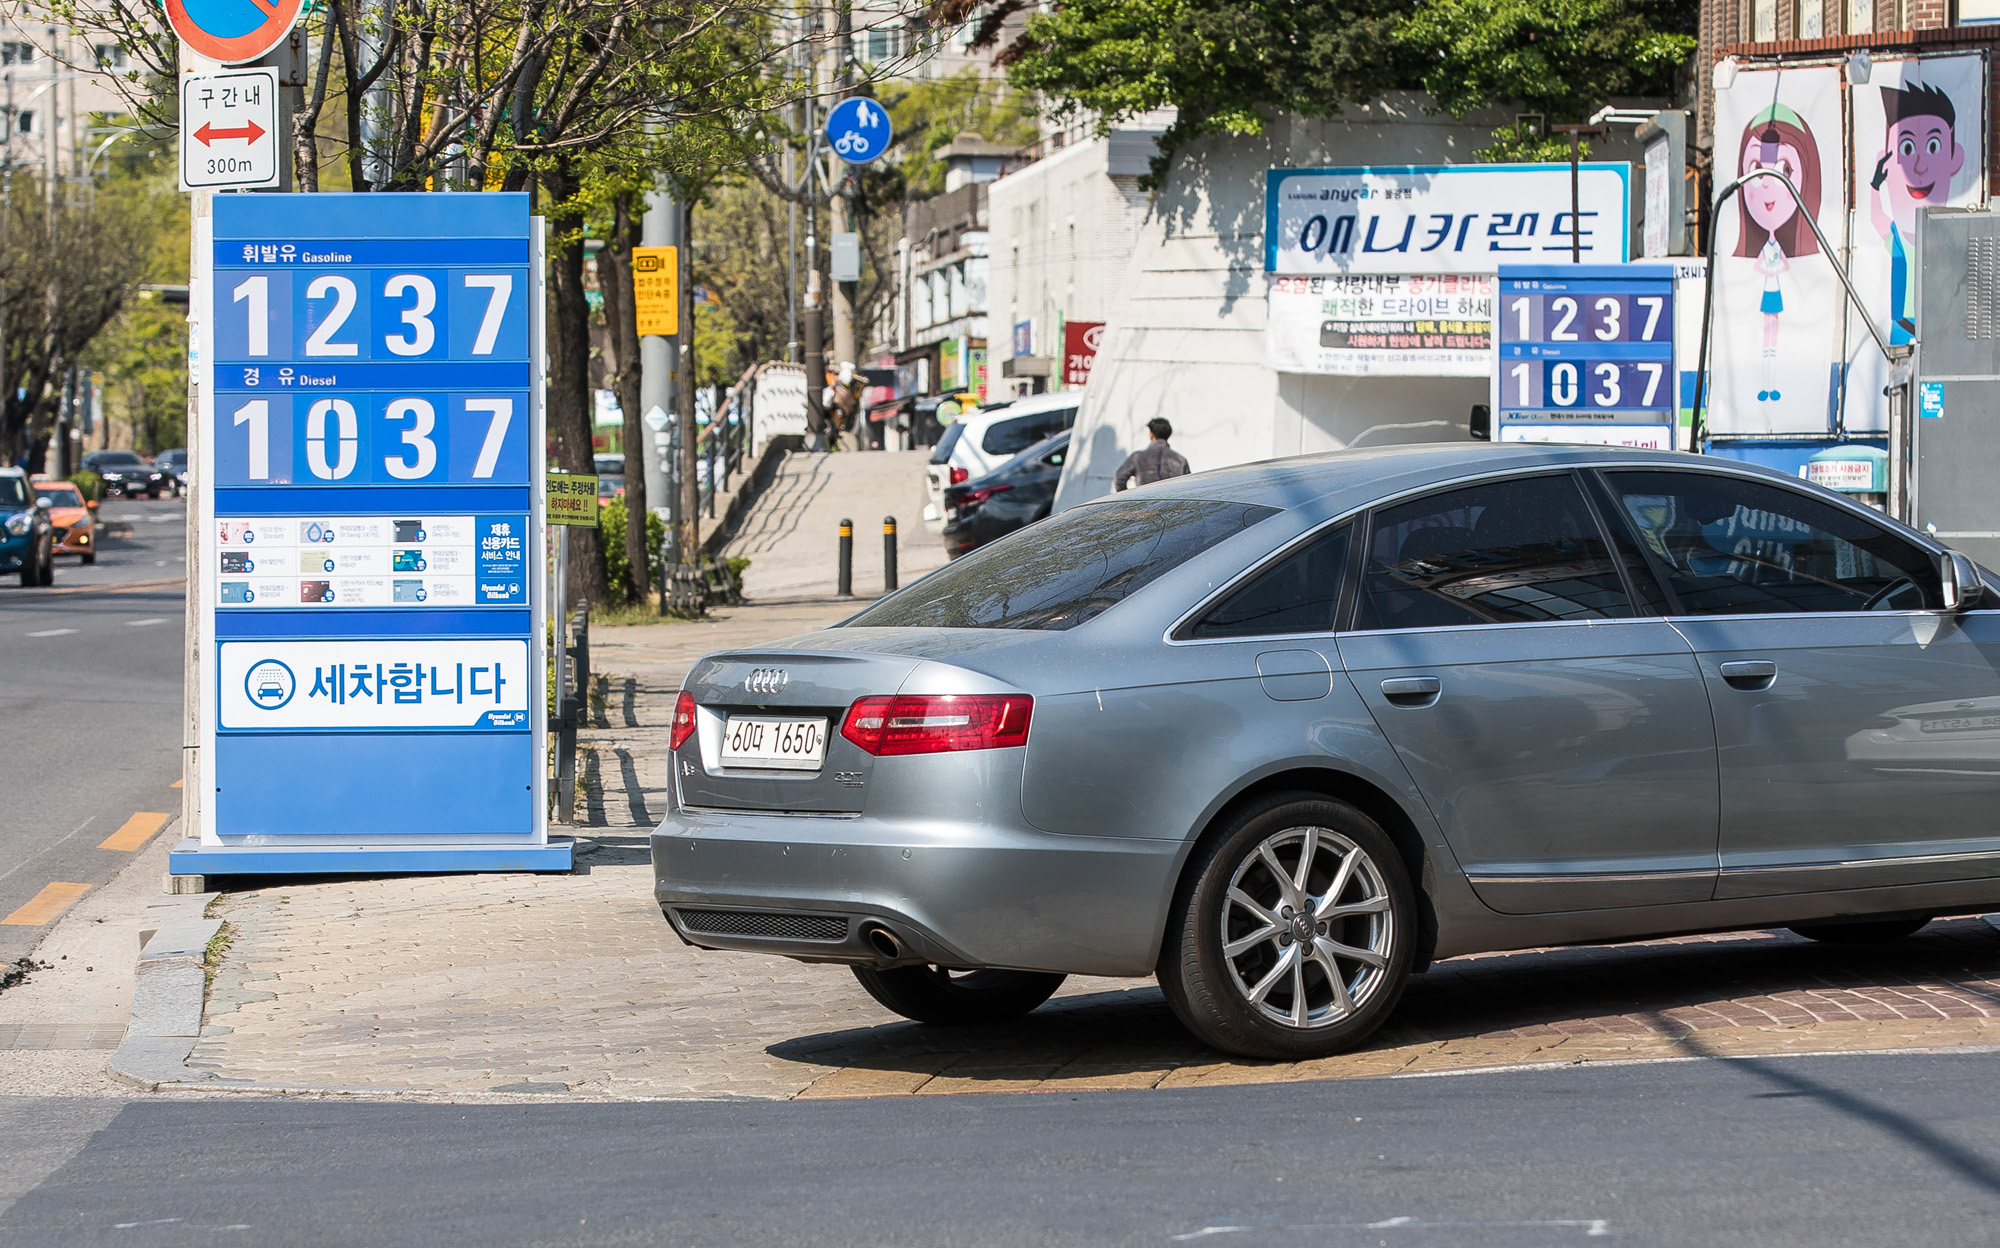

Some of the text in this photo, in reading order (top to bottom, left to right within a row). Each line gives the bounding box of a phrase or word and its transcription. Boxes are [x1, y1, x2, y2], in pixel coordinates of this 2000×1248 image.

[207, 158, 252, 174] 300m
[1319, 183, 1379, 202] anycar
[1300, 212, 1599, 253] 애니카랜드
[243, 244, 352, 263] 휘발유 Gasoline
[1274, 276, 1324, 294] 오염된
[1332, 276, 1400, 294] 차량내부
[1514, 280, 1540, 290] 휘발유
[233, 273, 512, 356] 1237
[1322, 298, 1491, 317] 쾌적한 드라이브 하세
[1512, 296, 1664, 341] 1237
[300, 375, 336, 386] Diesel
[1512, 362, 1663, 407] 1037
[233, 397, 513, 480] 1037
[1840, 464, 1870, 474] 사용금지
[546, 480, 596, 496] 인도에는 주정차를
[551, 497, 582, 512] 하지마세요
[490, 523, 511, 536] 제휴
[481, 536, 520, 550] 신용카드
[481, 550, 520, 560] 서비스 안내
[481, 584, 506, 592] Hyundai
[309, 663, 506, 704] 세차합니다
[774, 722, 816, 754] 1650
